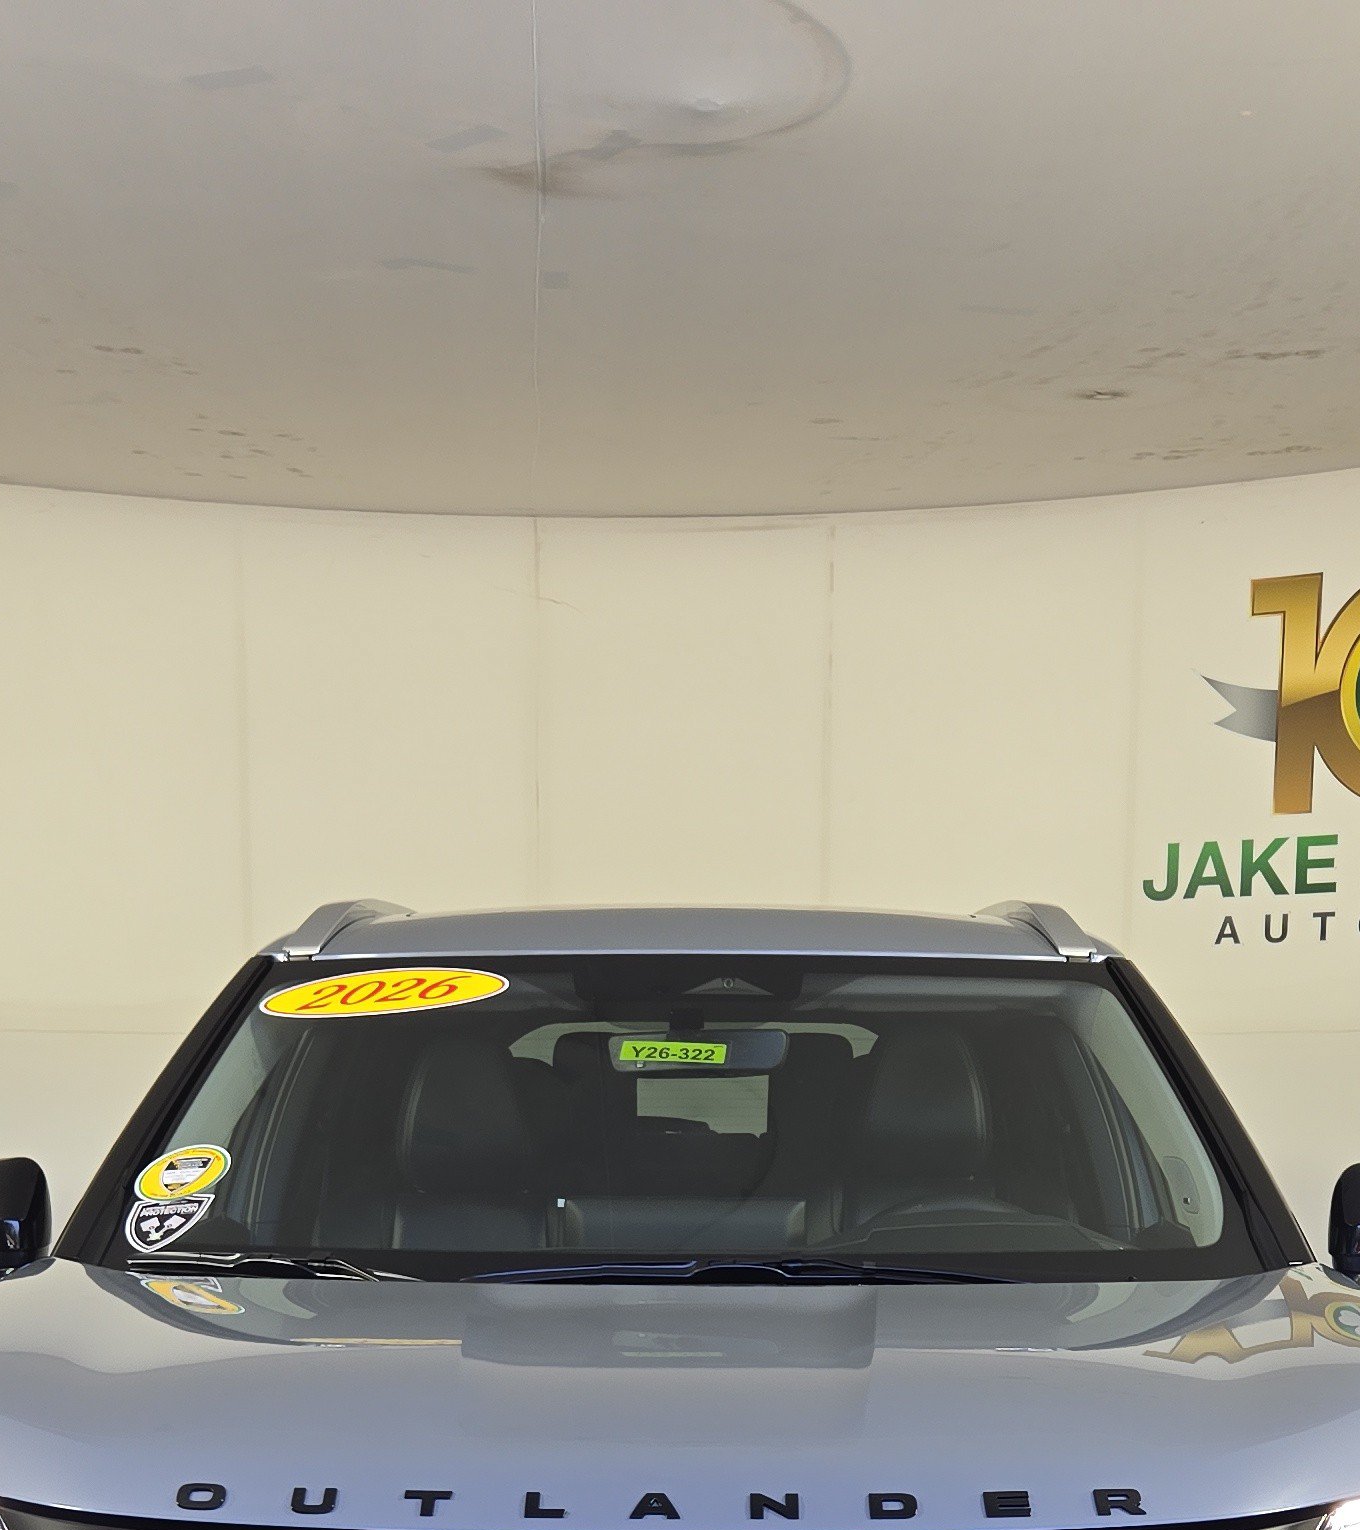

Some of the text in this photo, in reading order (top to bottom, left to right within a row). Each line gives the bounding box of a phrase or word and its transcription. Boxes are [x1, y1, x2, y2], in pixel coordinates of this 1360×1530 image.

[1142, 833, 1339, 902] JAKE
[294, 975, 473, 1012] 2026
[631, 1045, 716, 1061] Y26-322
[175, 1481, 1148, 1521] OUTLANDER
